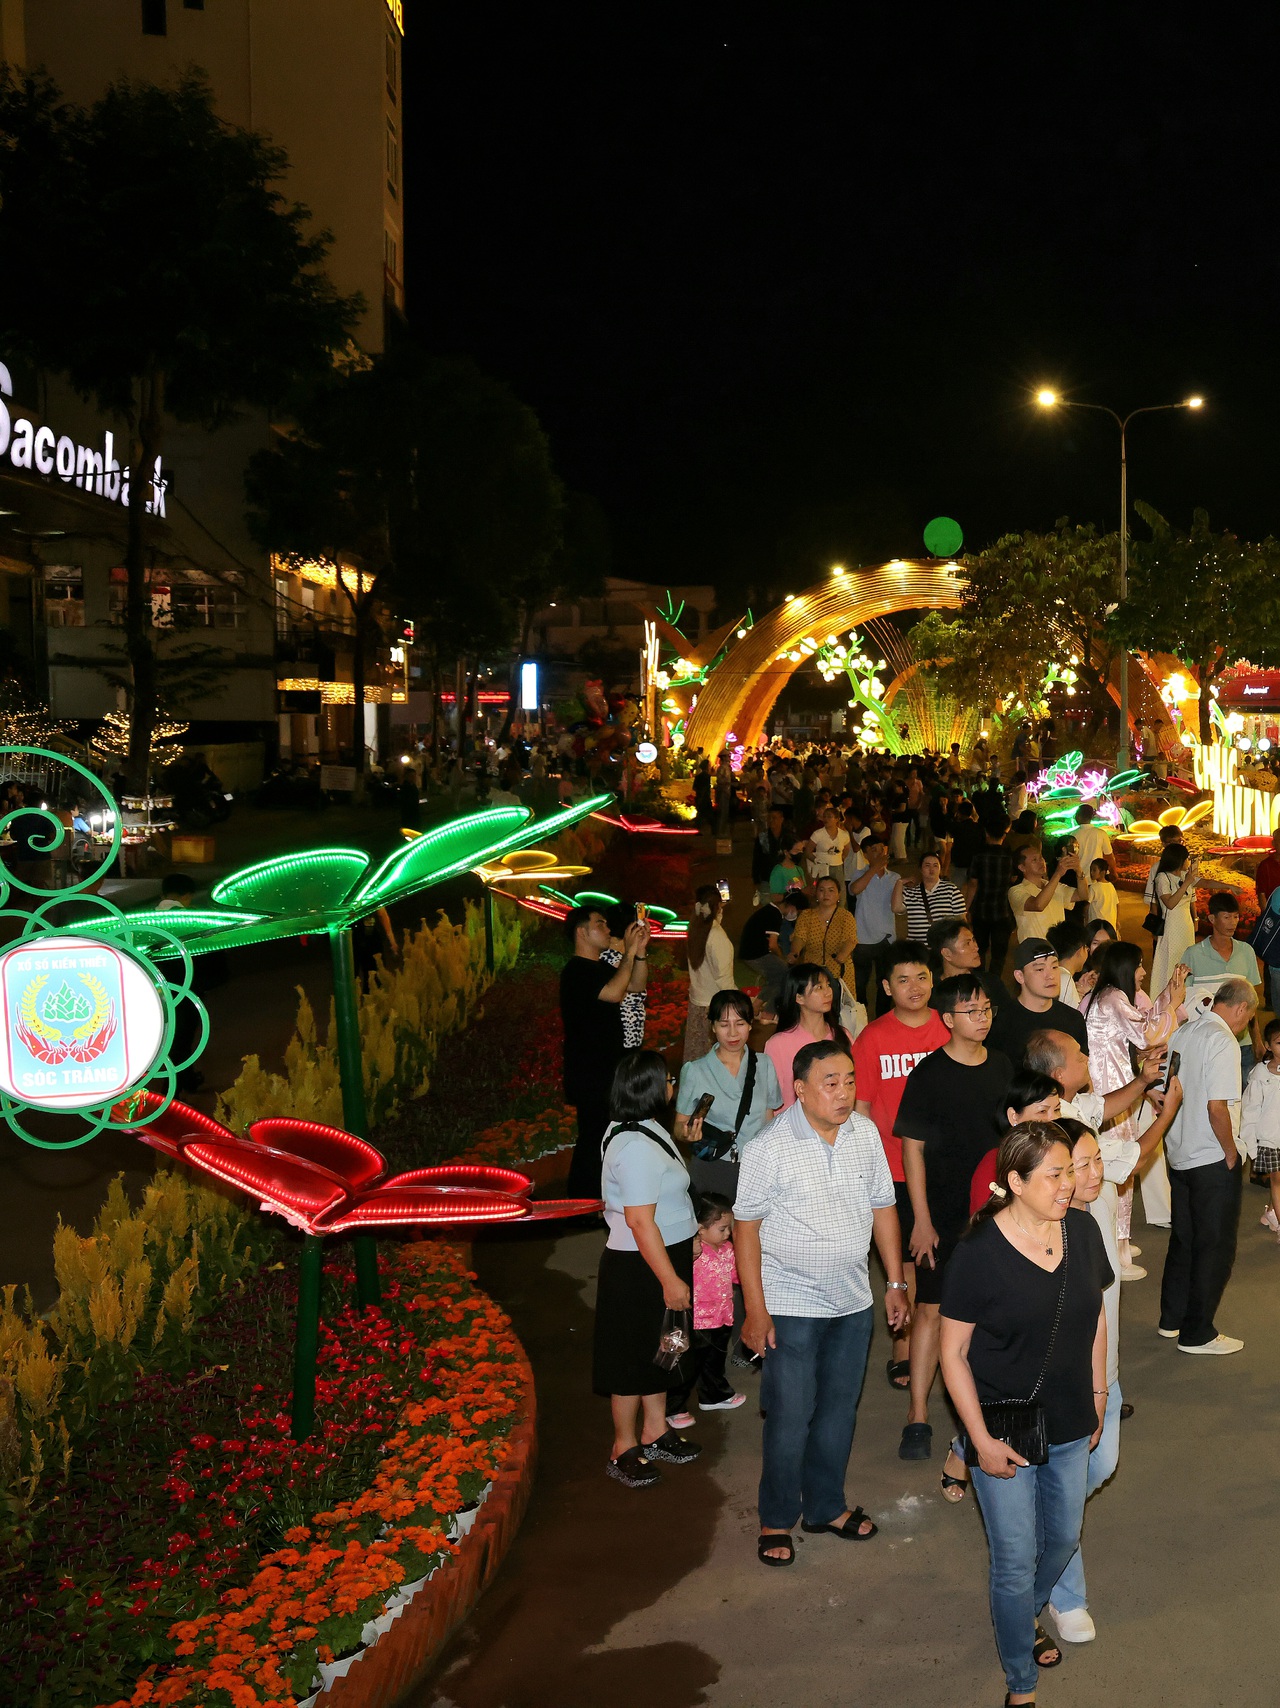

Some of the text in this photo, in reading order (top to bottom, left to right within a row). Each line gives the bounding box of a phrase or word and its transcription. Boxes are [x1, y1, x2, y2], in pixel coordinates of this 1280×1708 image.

[22, 1066, 118, 1087] SÓC TRĂNG
[880, 1051, 934, 1080] DICK
